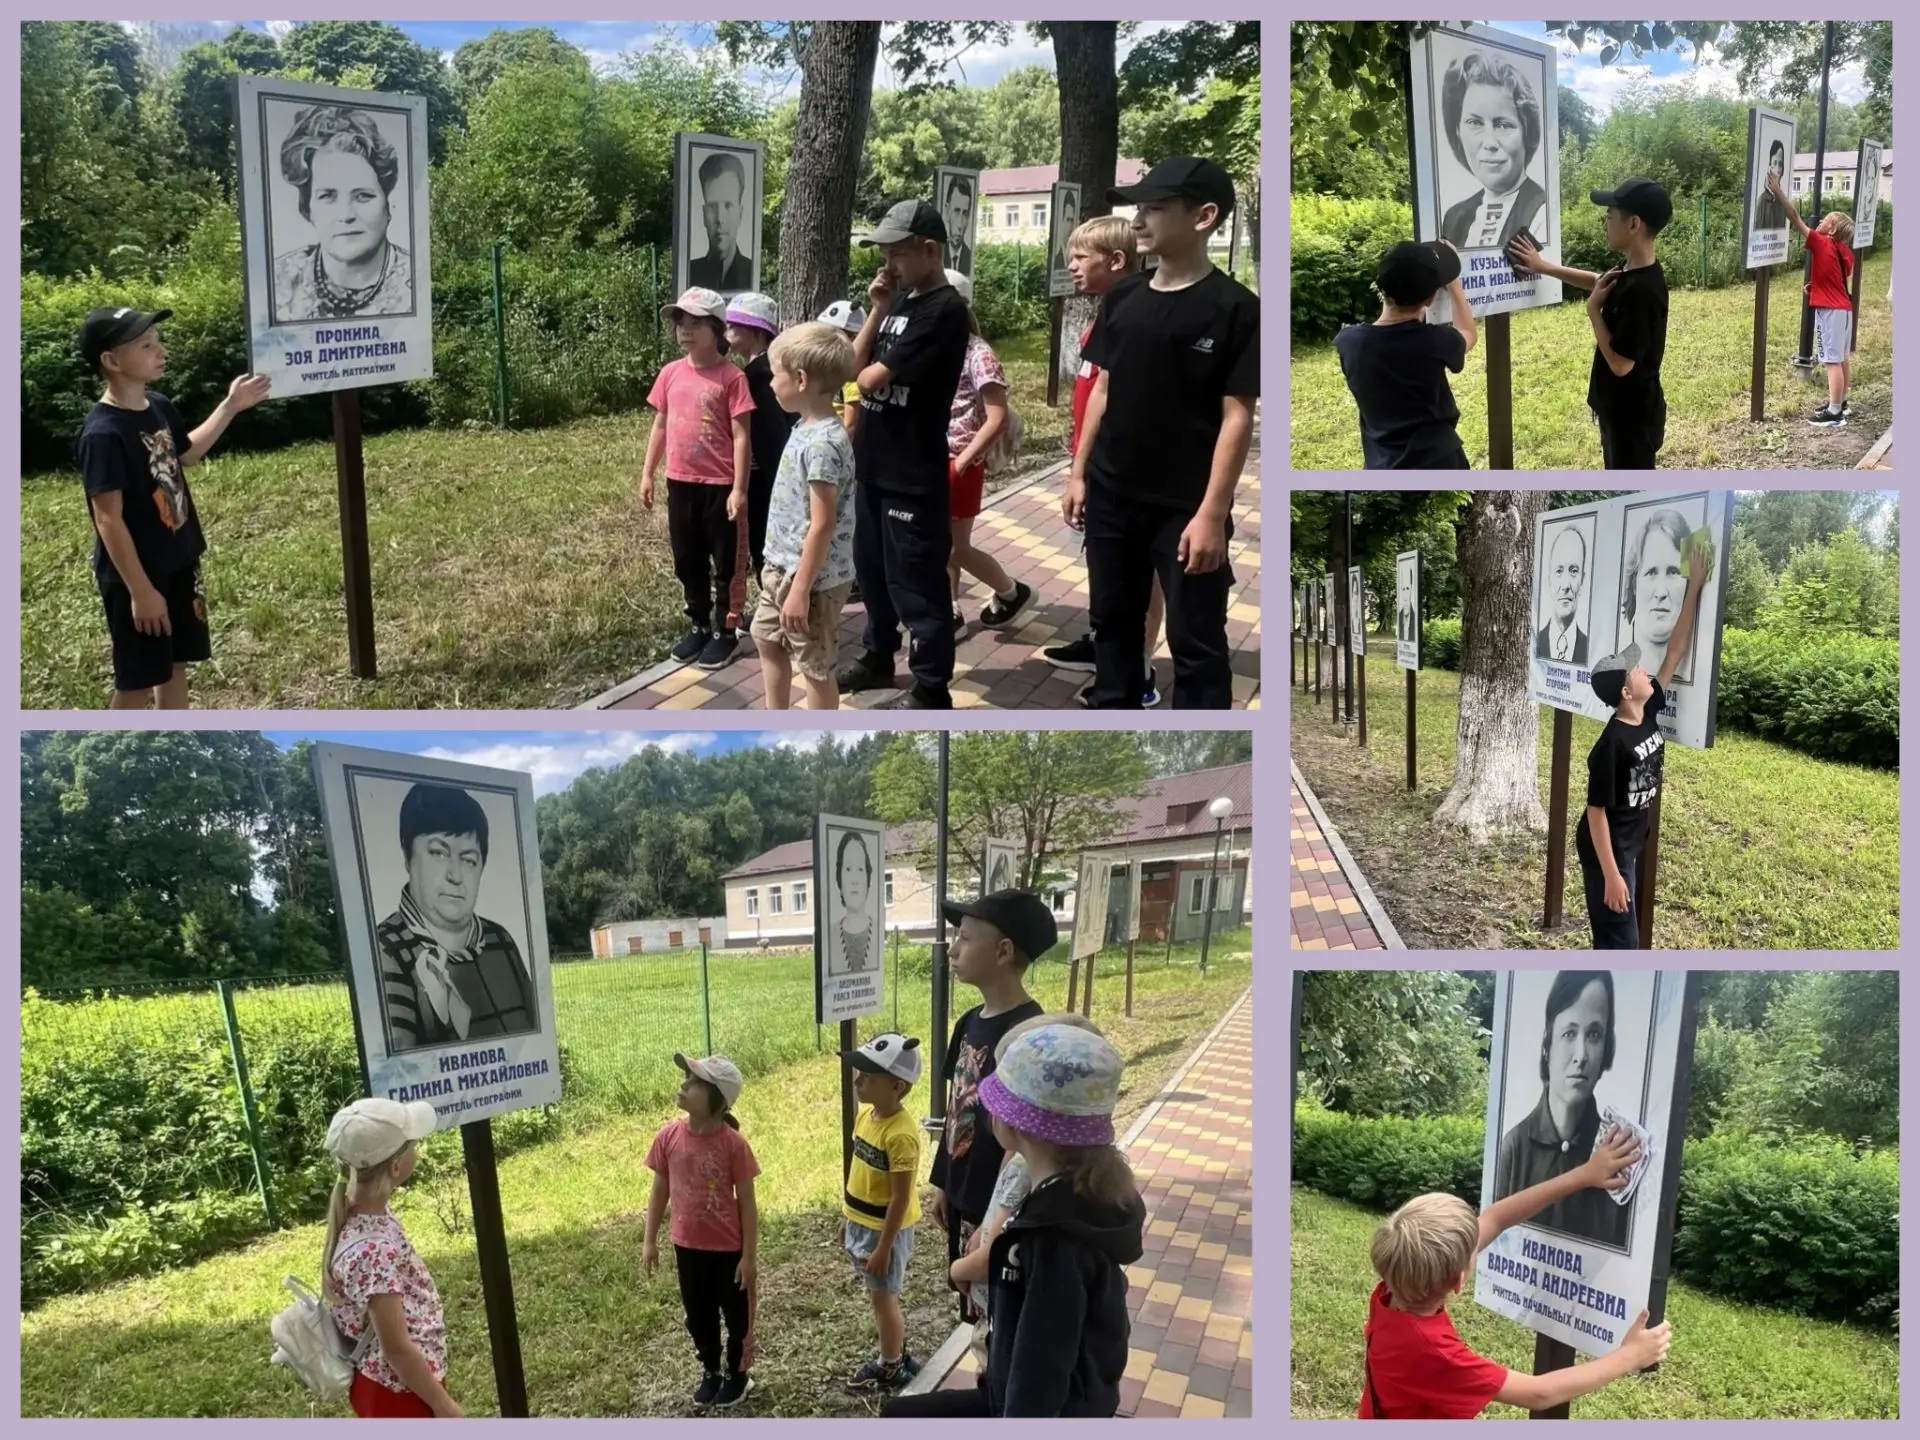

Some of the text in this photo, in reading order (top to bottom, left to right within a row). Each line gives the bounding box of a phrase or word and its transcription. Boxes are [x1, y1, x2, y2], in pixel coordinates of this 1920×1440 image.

[1461, 275, 1486, 290] ИНА
[1496, 288, 1536, 302] МАТЕМАТИКИ
[315, 326, 380, 344] ПРОНИНА
[285, 341, 407, 366] ЗОЯ ДМИТРИЕВНА
[301, 363, 396, 382] УЧИТЕЛЬ МАТЕМАТИКИ
[1546, 678, 1571, 692] ЕГОРОВИЧ
[1634, 731, 1664, 760] NEW
[439, 1048, 506, 1073] ИВАНОВА
[388, 1059, 549, 1101] ГАЛИНА МИХАЙЛОВНА
[435, 1088, 523, 1116] ЧИТЕЛЬ ГЕОГРАФИИ
[1522, 1238, 1582, 1275] ИВАНОВА
[1488, 1252, 1627, 1320] ВАРВАРА АНДРЕЕВНА
[1492, 1283, 1615, 1344] УЧИТЕЛЬ НАЧАЛЬНЫХ КЛАССОВ
